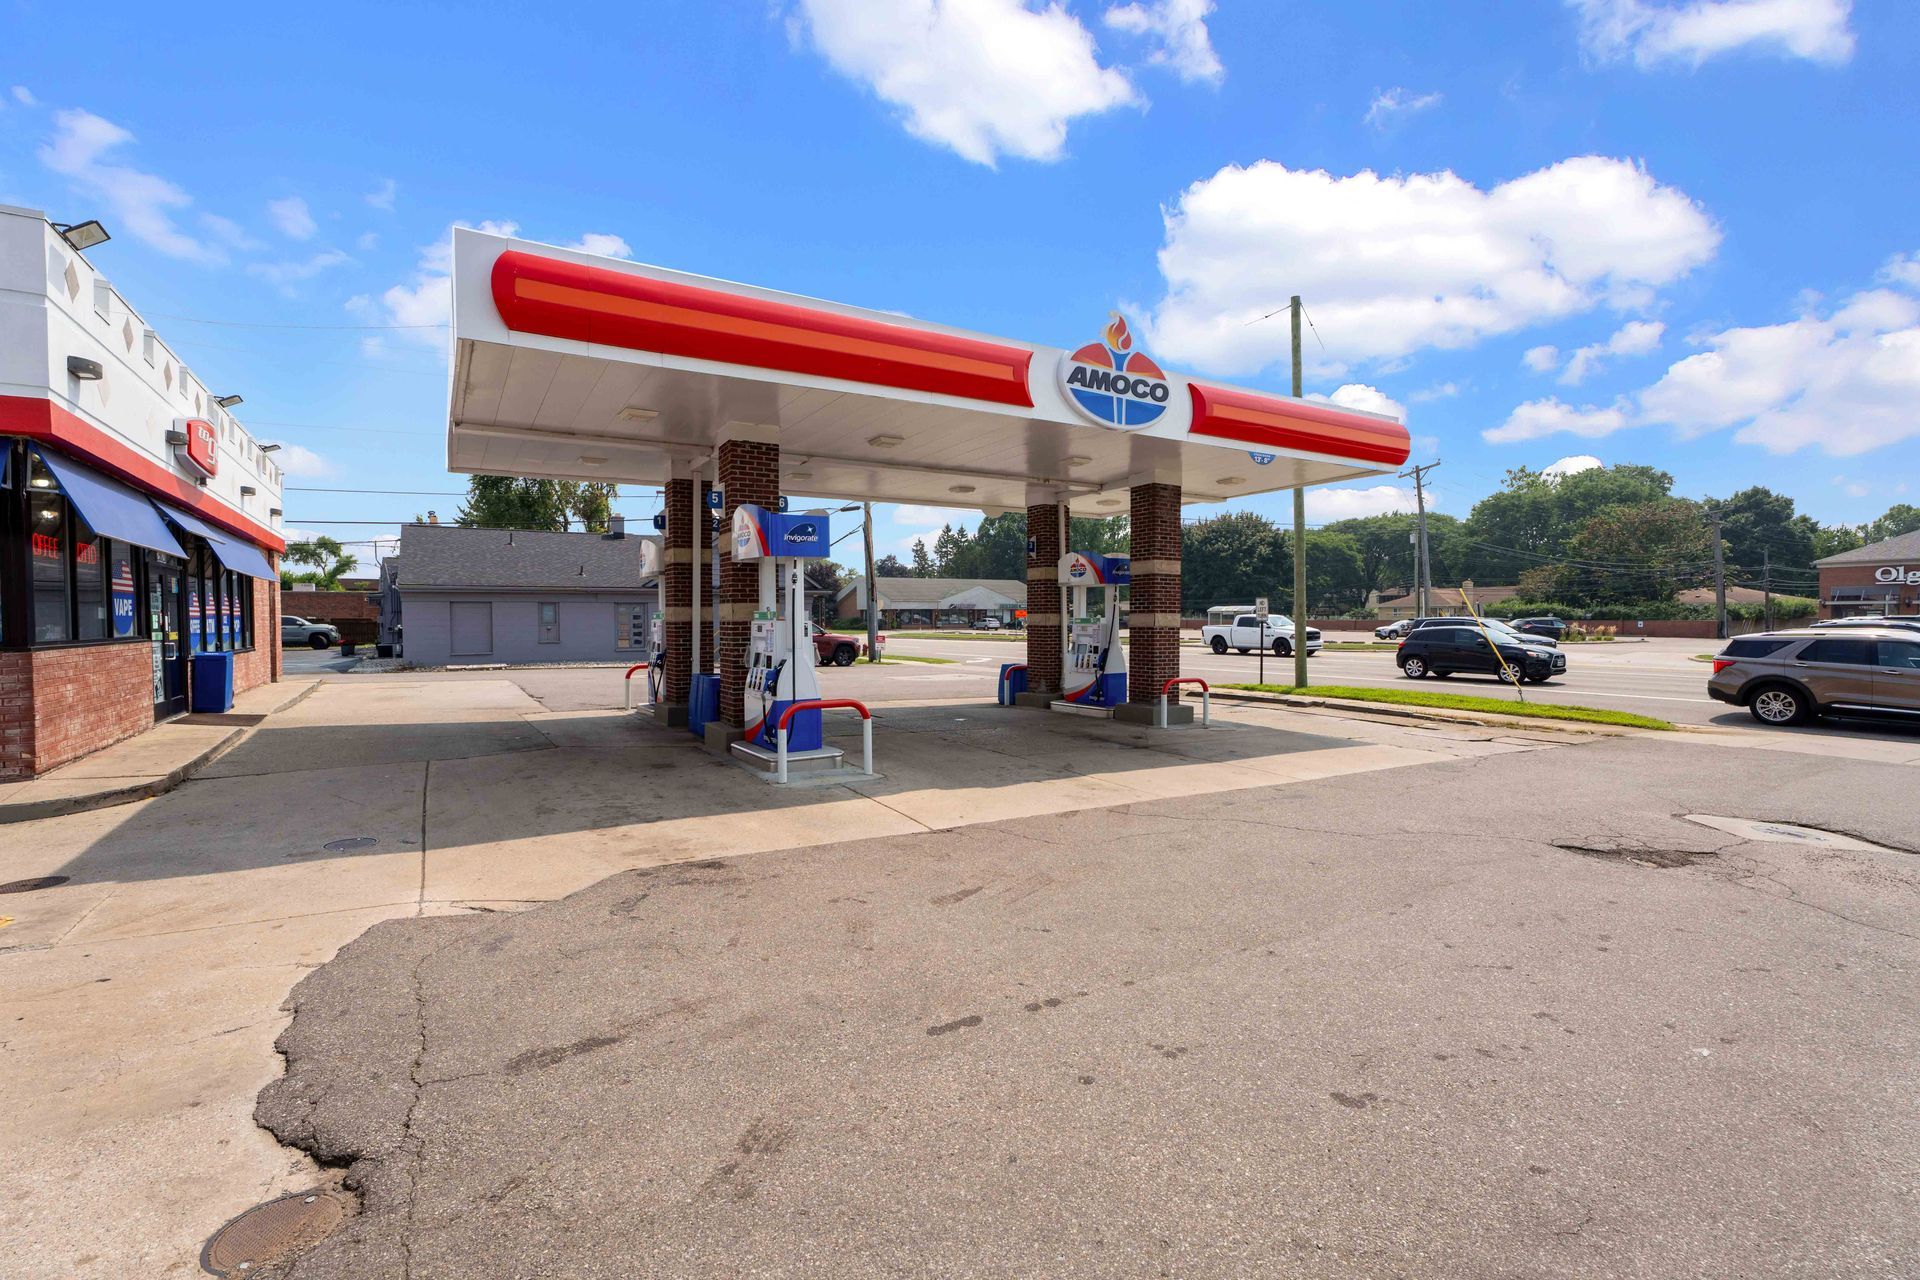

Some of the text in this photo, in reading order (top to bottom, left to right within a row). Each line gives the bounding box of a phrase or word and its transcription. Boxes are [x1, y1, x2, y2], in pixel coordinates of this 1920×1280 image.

[1066, 366, 1169, 402] AMOCO
[712, 493, 718, 503] 5
[779, 498, 785, 507] 6
[658, 515, 662, 525] 1
[712, 520, 718, 528] 2
[784, 533, 818, 543] Invigorate
[32, 532, 59, 559] OFFEE
[114, 598, 133, 617] VAPE
